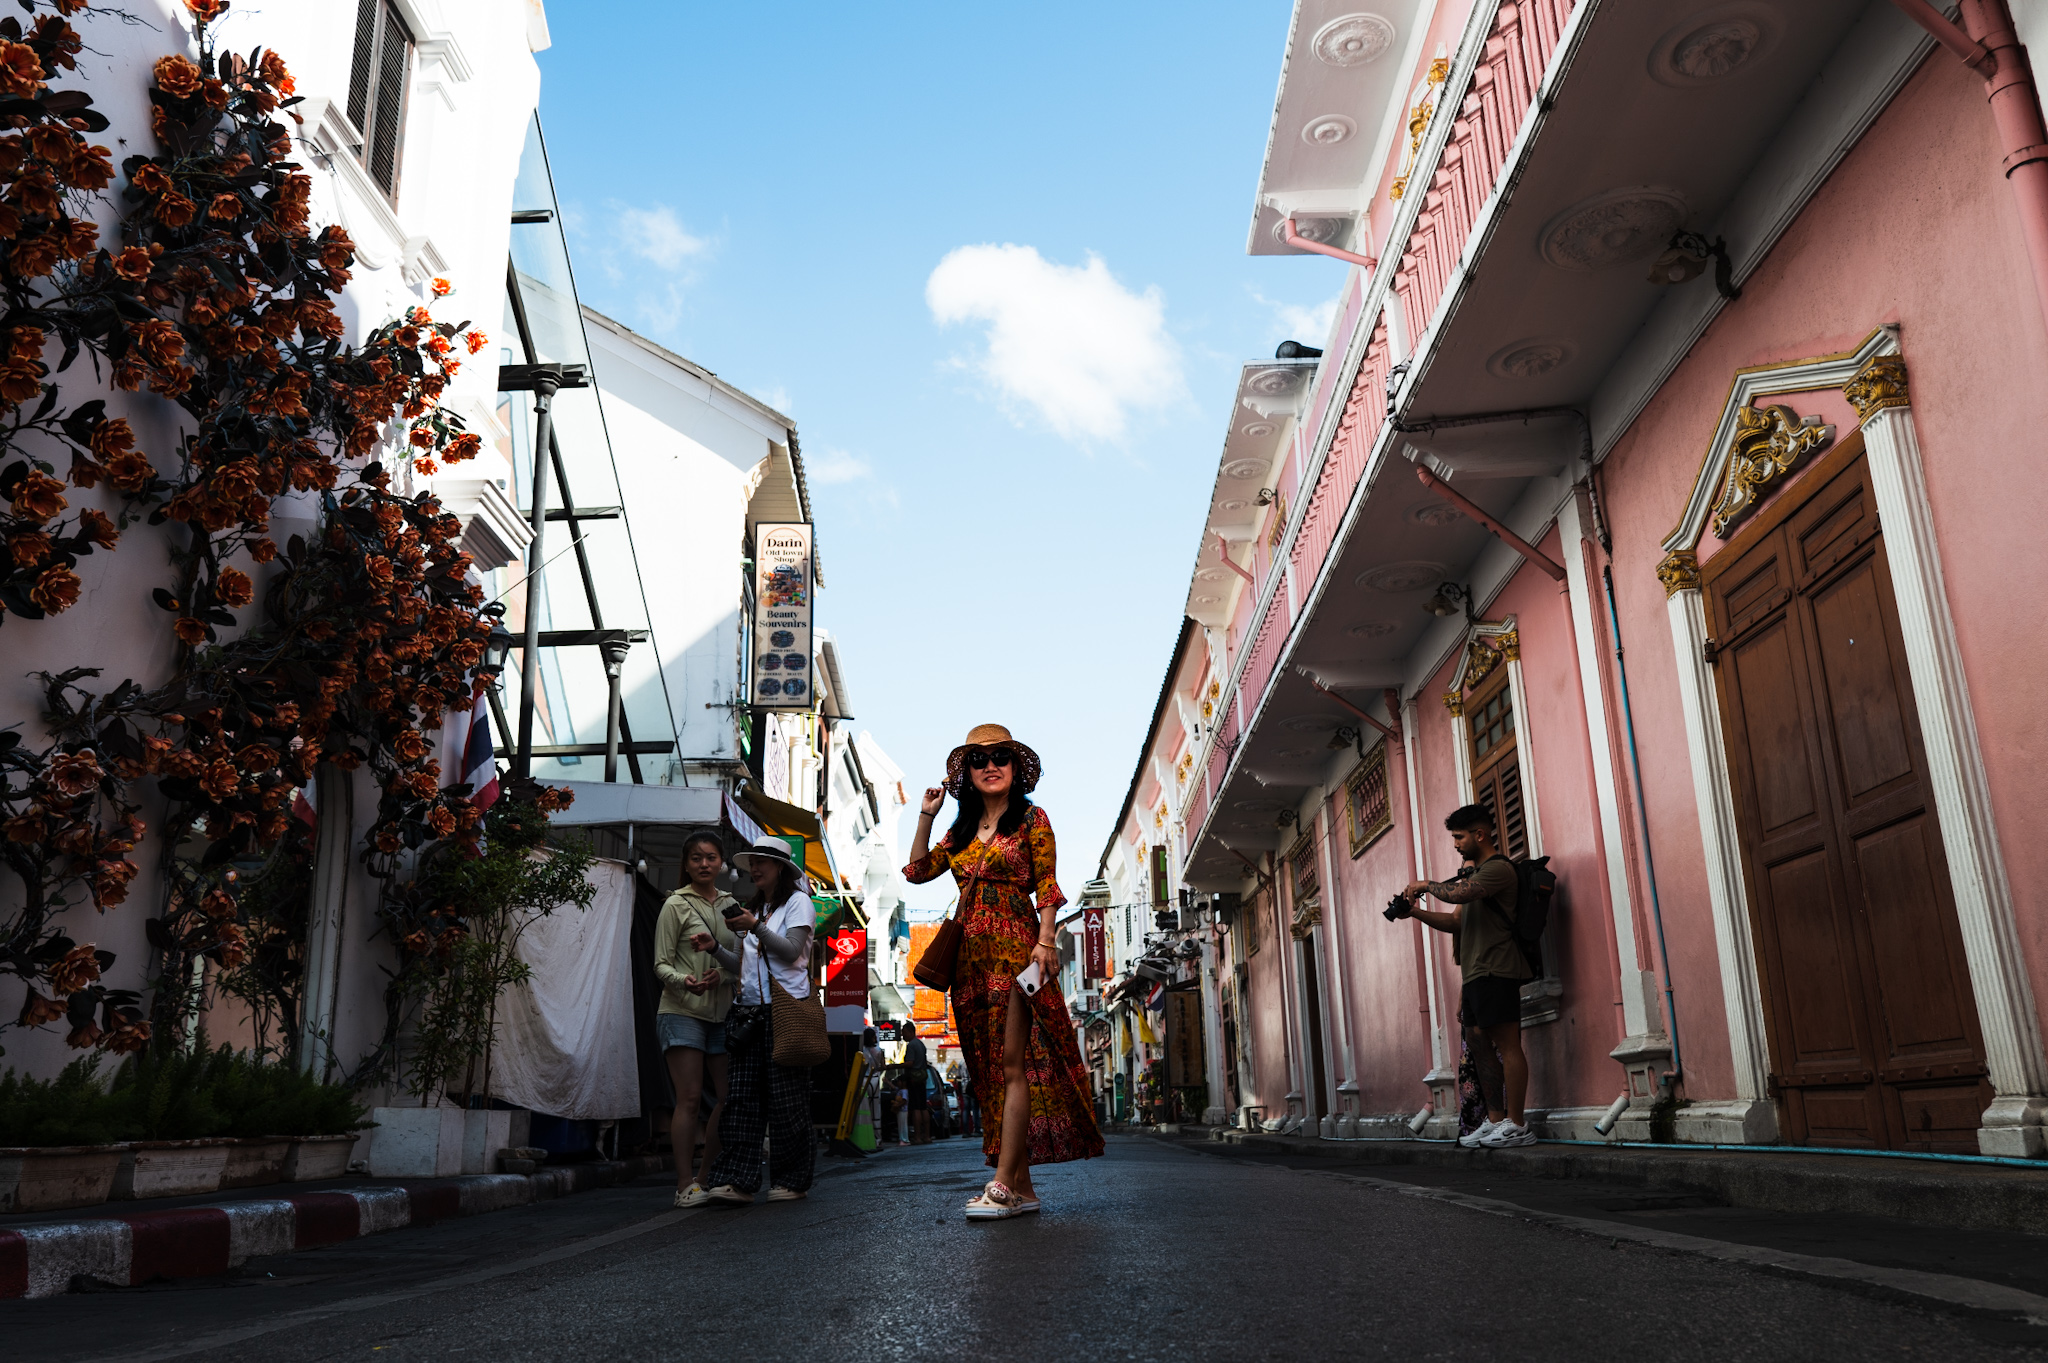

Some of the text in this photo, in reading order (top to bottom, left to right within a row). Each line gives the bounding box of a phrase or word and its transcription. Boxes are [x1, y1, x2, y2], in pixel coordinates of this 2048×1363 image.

[767, 538, 802, 547] Darin
[767, 610, 799, 620] Beauty
[758, 619, 807, 628] Souvenirs
